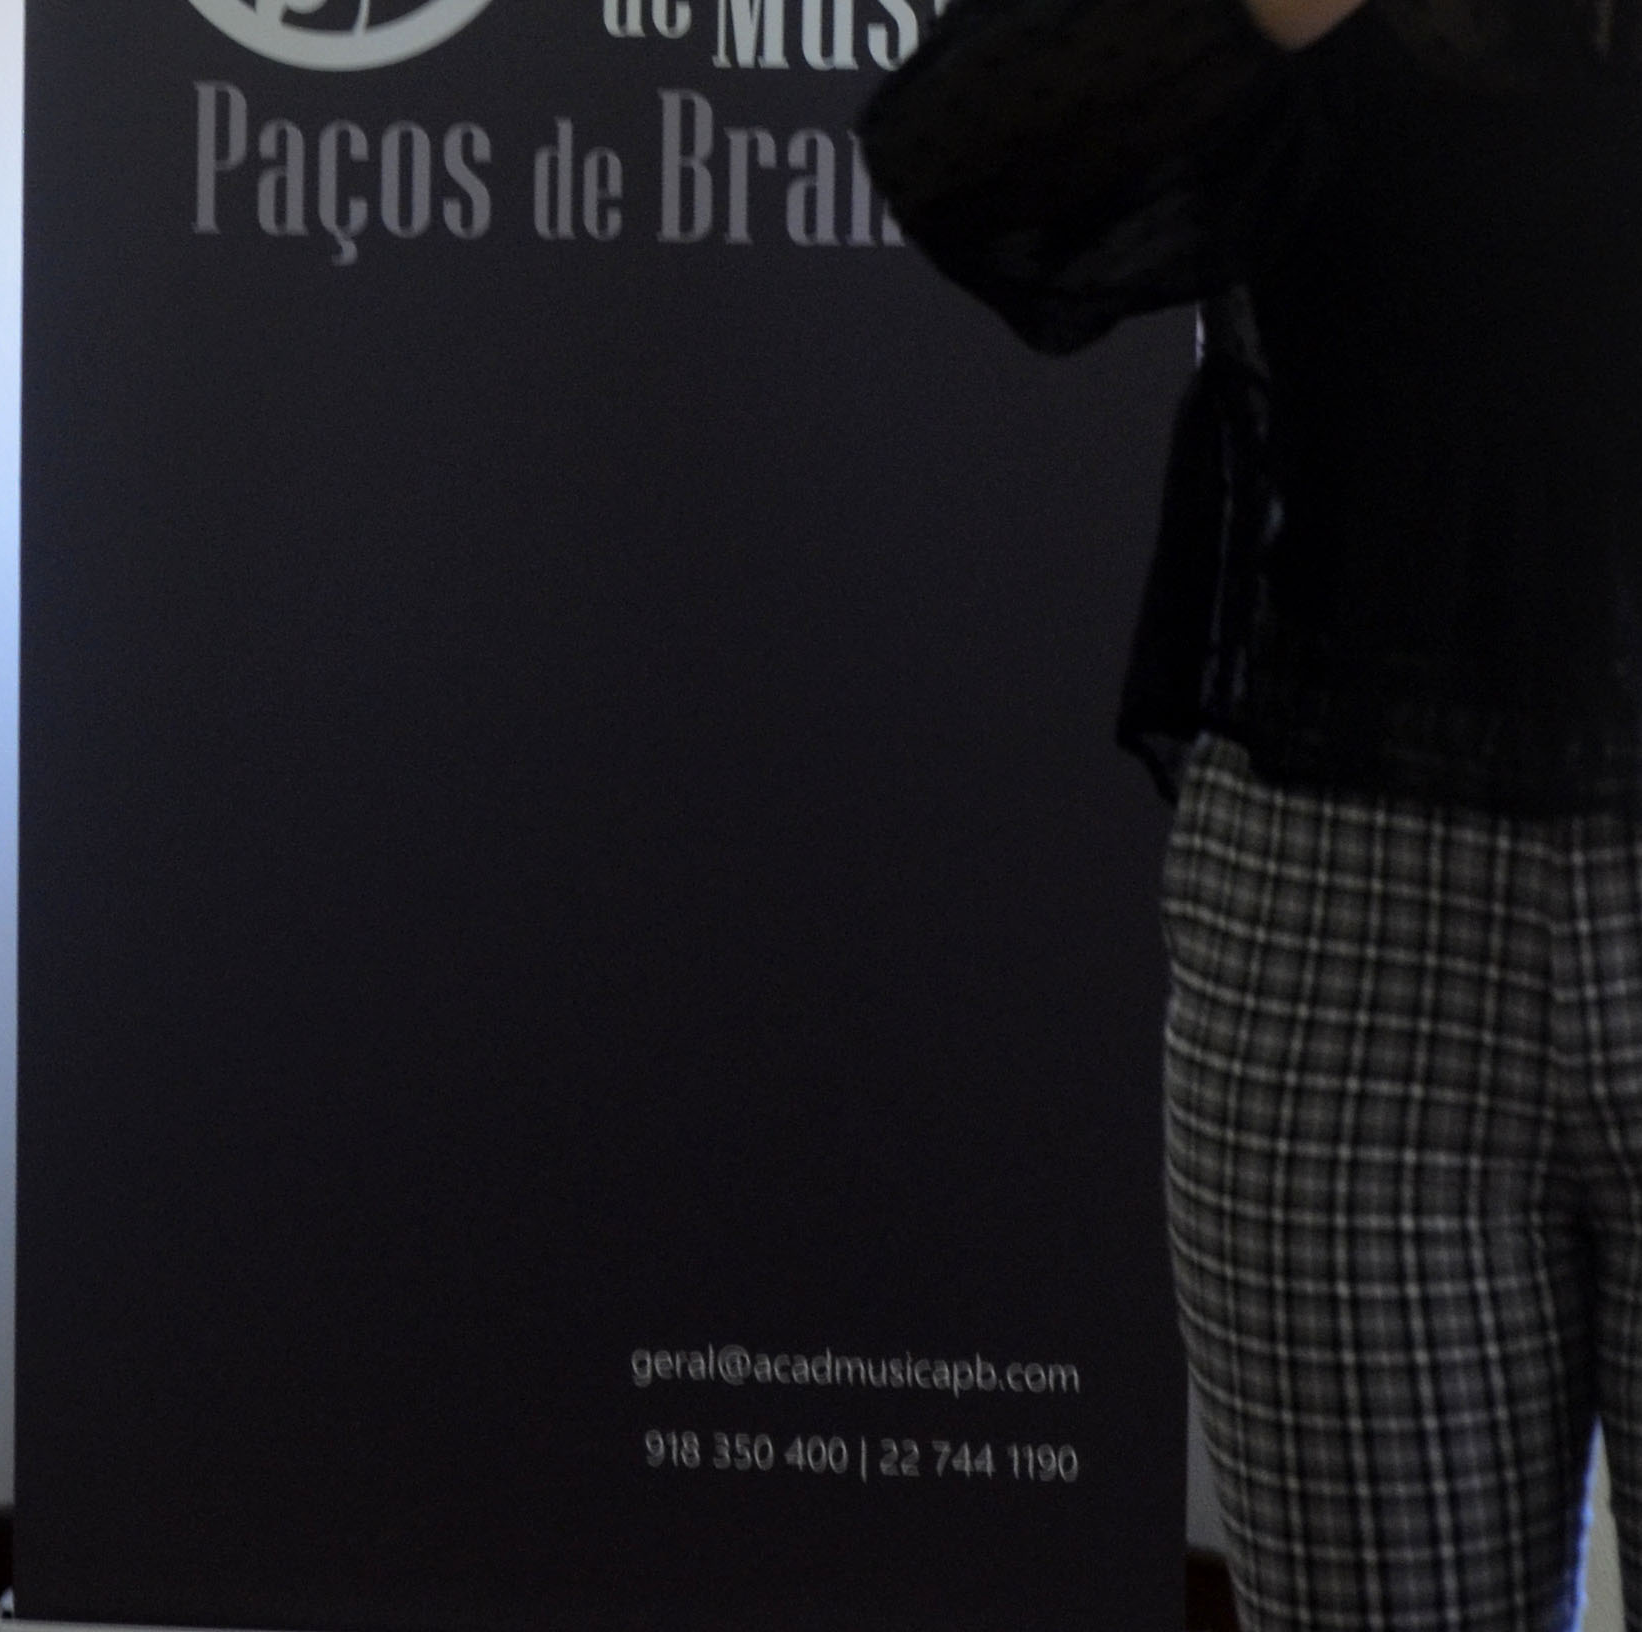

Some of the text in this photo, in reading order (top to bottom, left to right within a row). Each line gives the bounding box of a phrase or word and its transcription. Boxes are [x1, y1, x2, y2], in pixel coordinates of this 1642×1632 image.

[193, 80, 493, 267] Paços
[532, 117, 624, 241] de
[630, 1342, 1082, 1399] geral@acadmusicapb.com
[643, 1430, 703, 1470] 918
[711, 1431, 776, 1472] 350
[782, 1434, 850, 1475] 400
[877, 1437, 922, 1478] 22
[931, 1439, 997, 1479] 744
[1007, 1440, 1081, 1483] 1190
